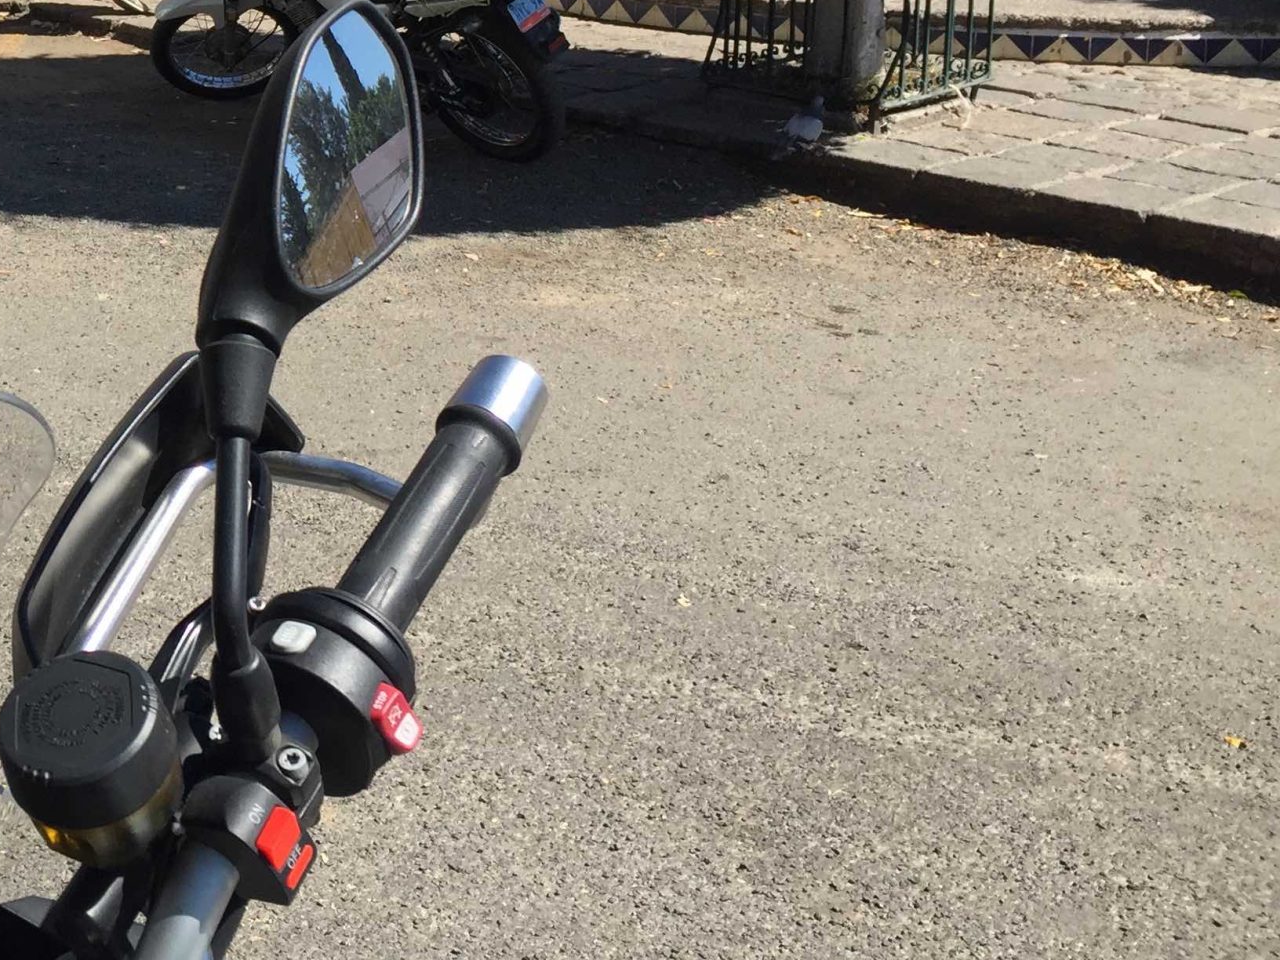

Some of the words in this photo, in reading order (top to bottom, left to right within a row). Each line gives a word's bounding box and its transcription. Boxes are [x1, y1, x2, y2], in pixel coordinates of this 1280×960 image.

[373, 691, 388, 710] STOP
[248, 803, 265, 824] ON
[286, 843, 302, 869] OFF
